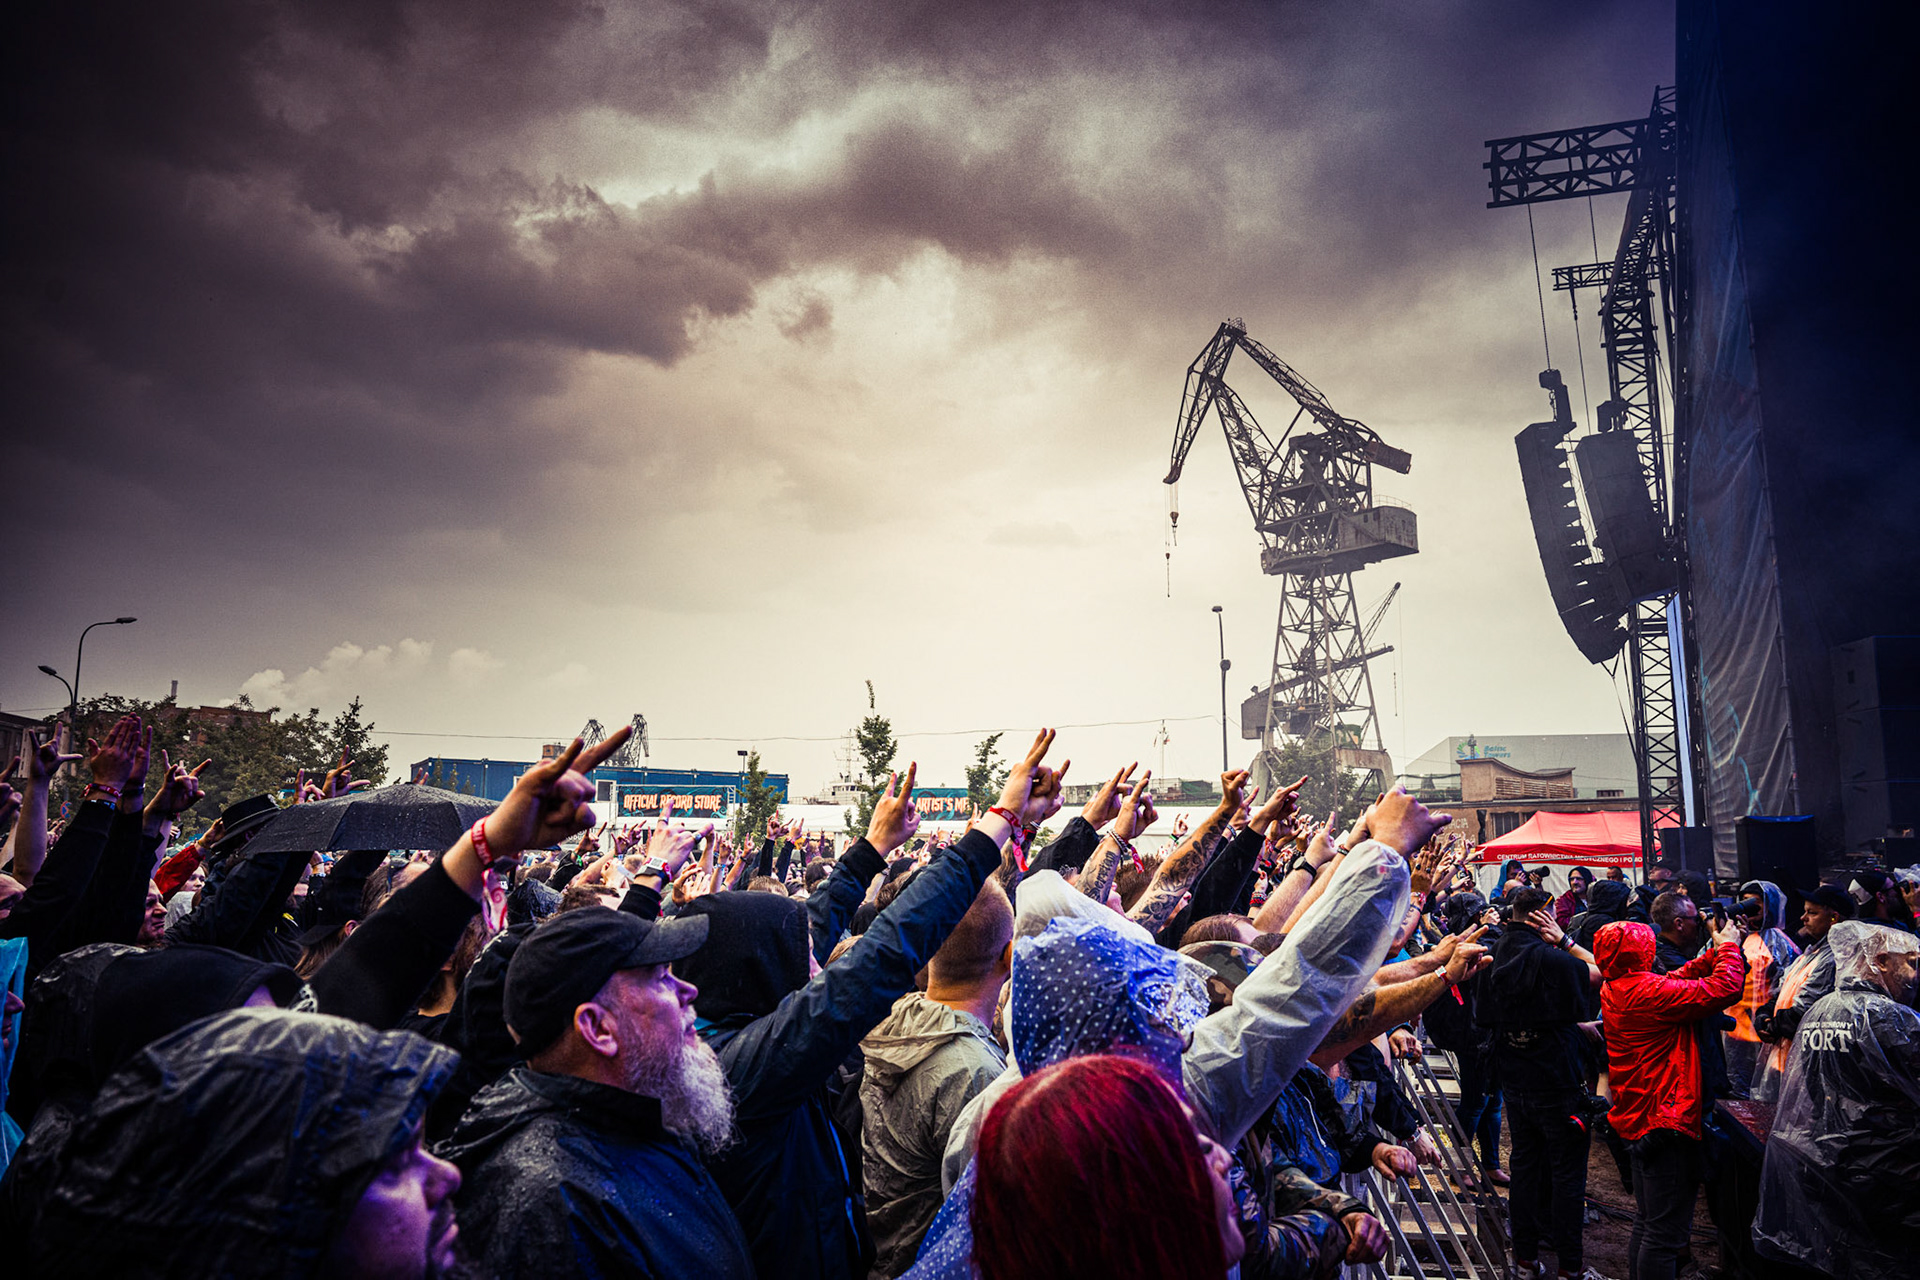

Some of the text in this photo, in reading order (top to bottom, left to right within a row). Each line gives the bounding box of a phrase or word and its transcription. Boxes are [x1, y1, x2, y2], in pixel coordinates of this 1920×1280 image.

[623, 794, 658, 811] OFFICIAL
[694, 794, 722, 812] STORE
[915, 797, 954, 814] ARTIST'S
[1801, 1028, 1852, 1053] FORT
